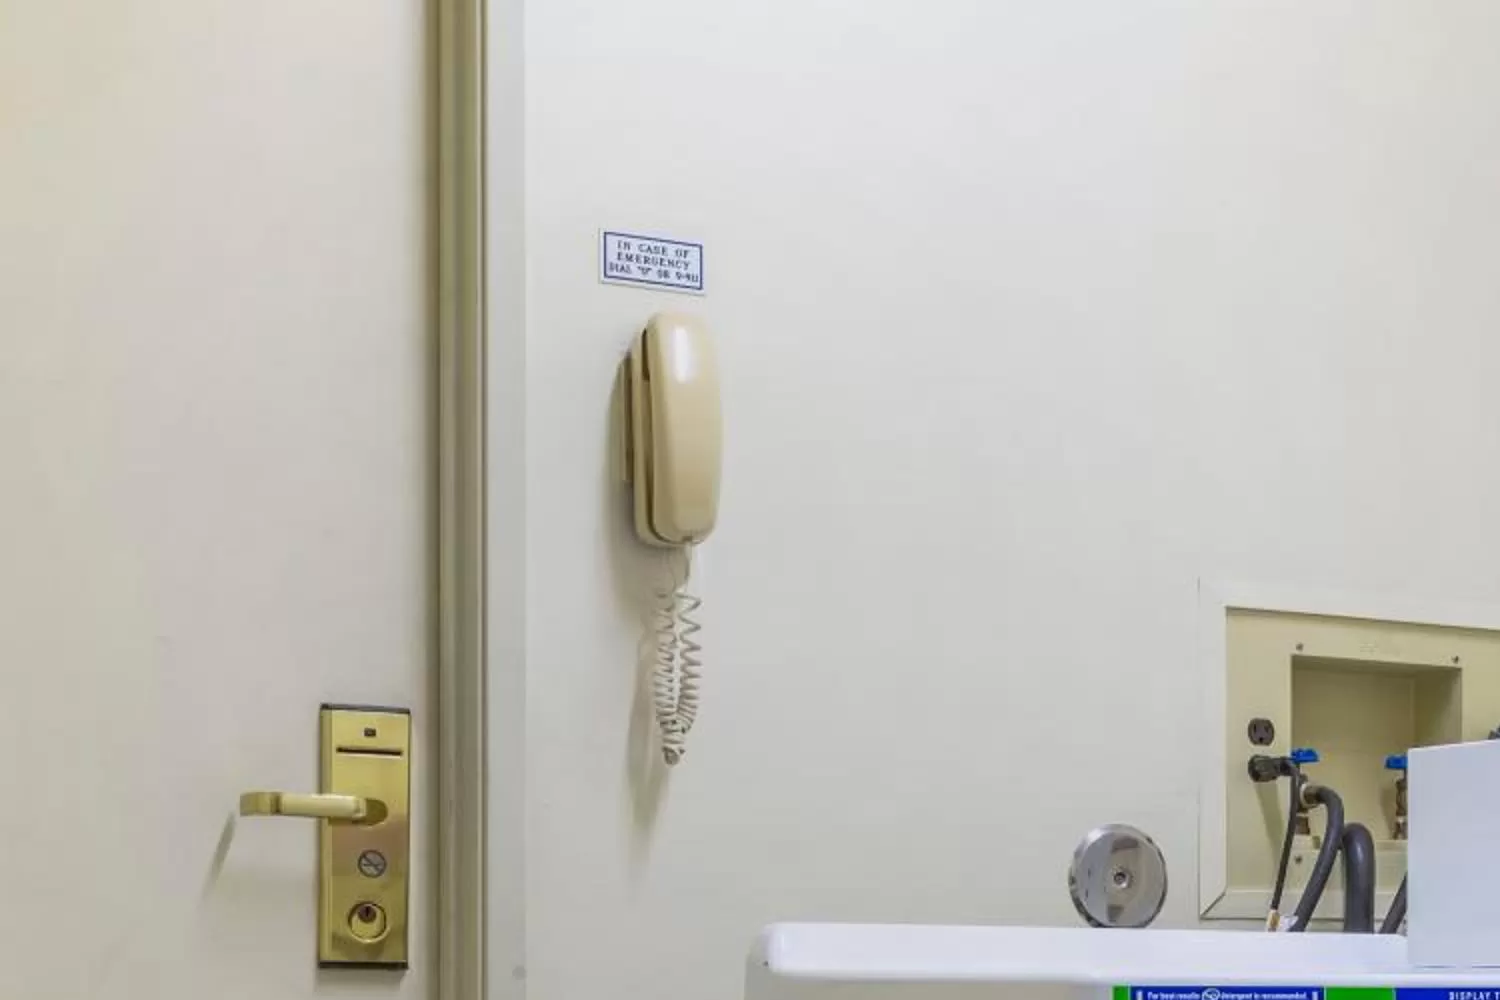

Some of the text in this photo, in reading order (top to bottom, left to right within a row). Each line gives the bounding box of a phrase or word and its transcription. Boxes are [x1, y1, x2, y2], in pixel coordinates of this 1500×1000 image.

[617, 240, 690, 259] IN CASE OF
[617, 252, 689, 269] EMERGENCY
[1448, 991, 1491, 1000] DISPLAY
